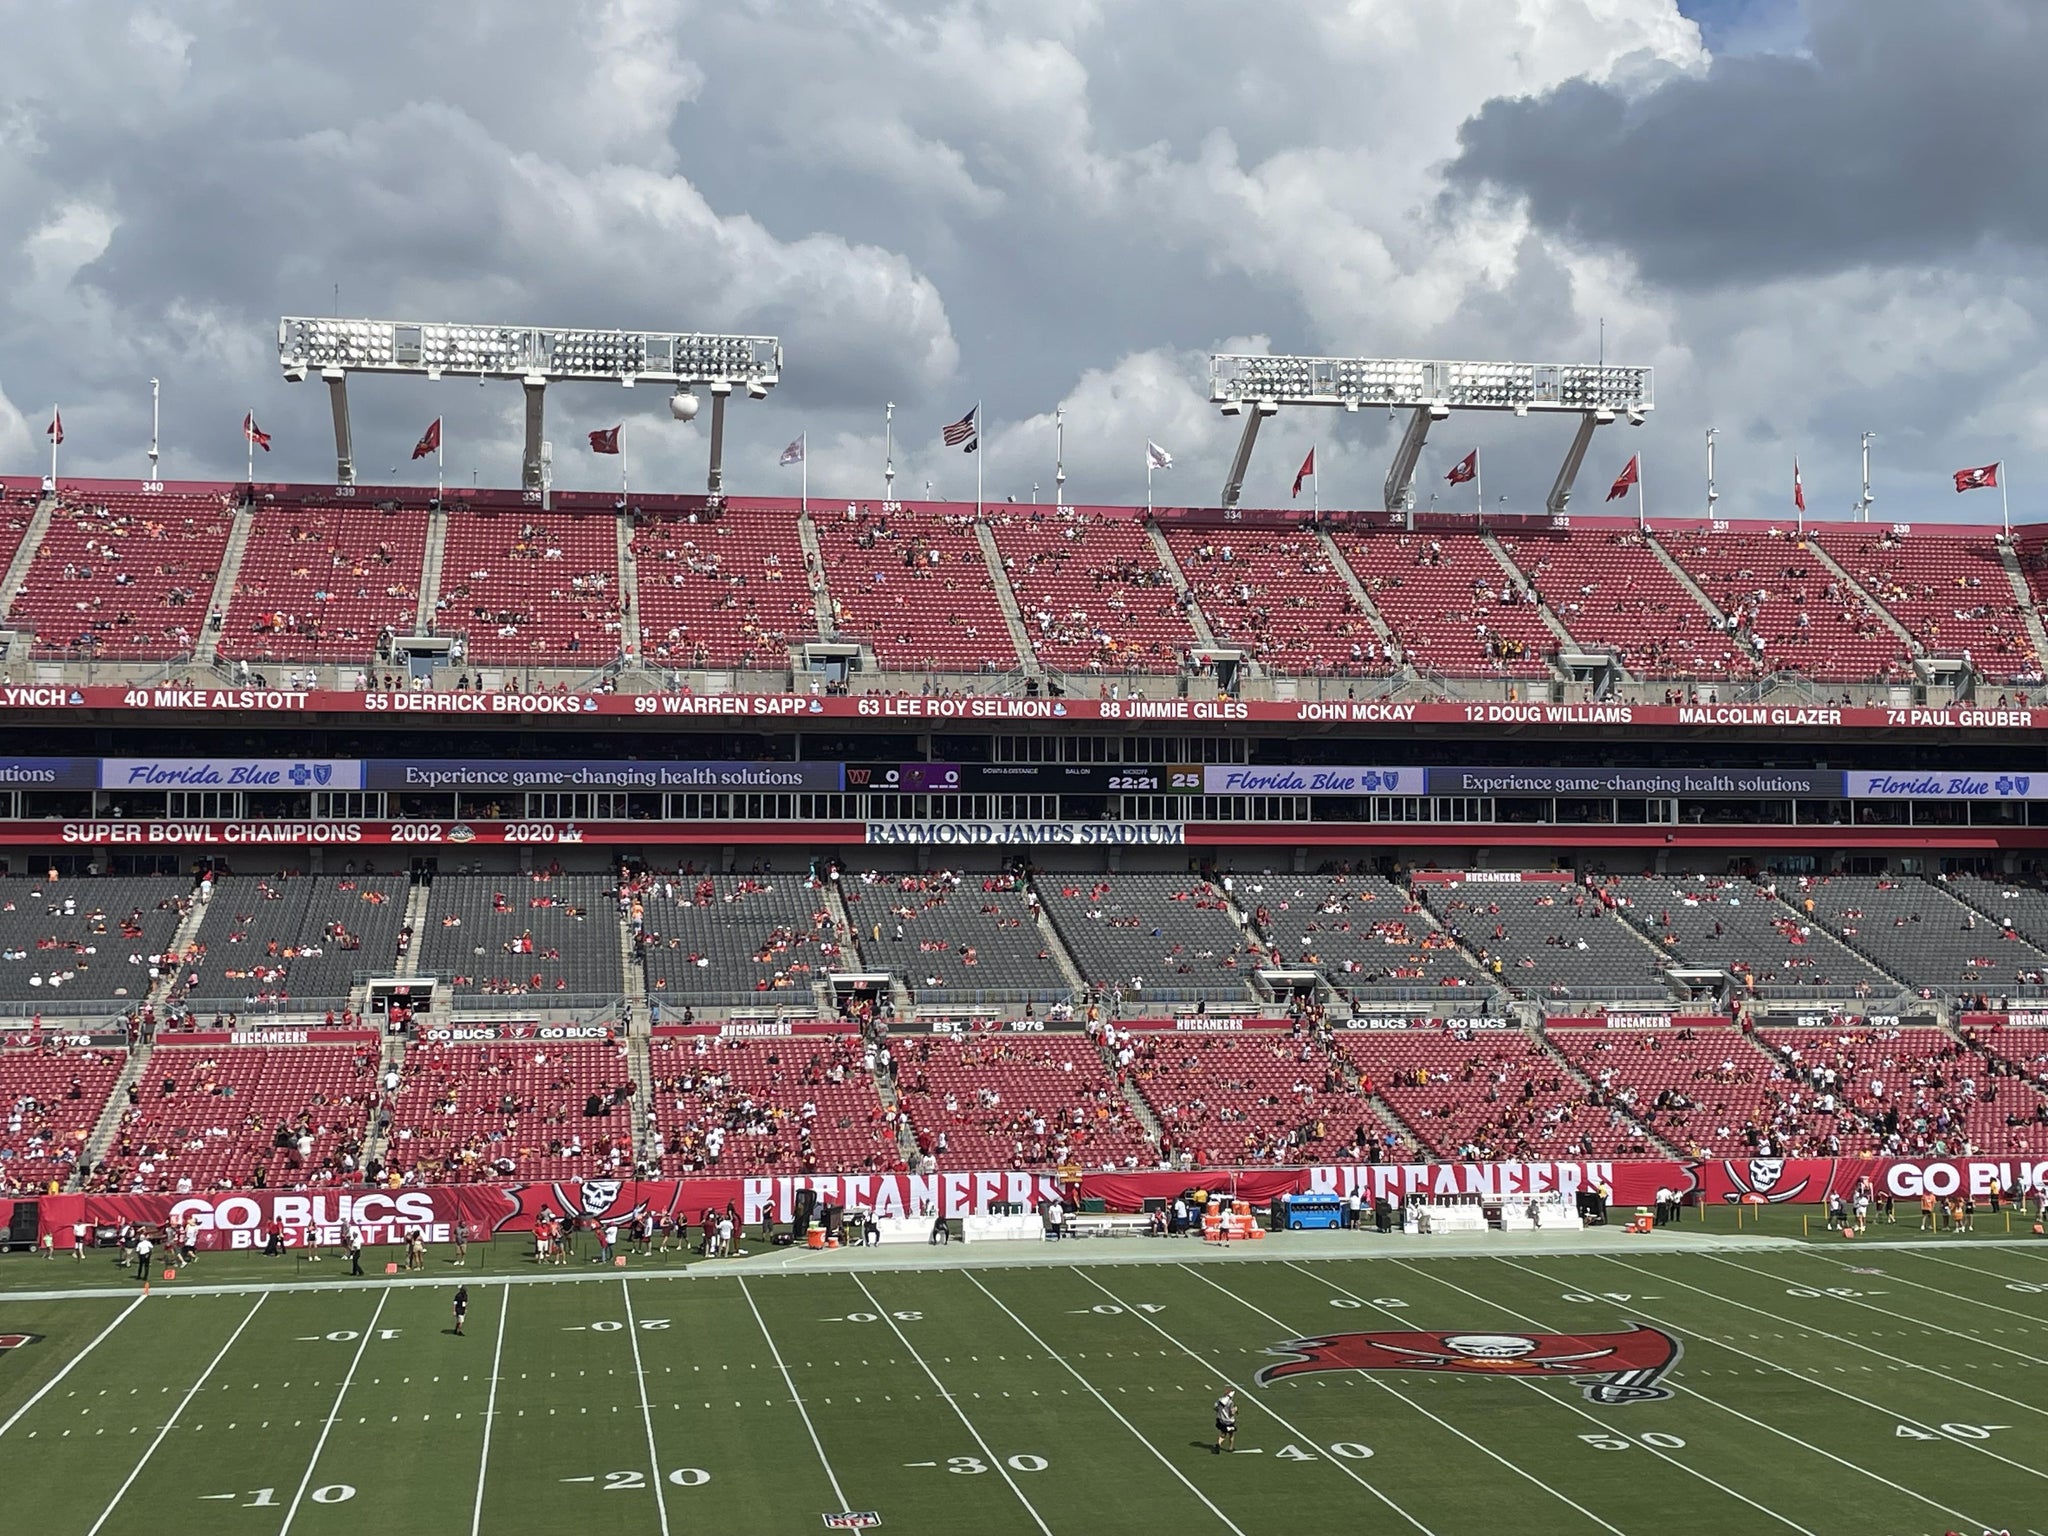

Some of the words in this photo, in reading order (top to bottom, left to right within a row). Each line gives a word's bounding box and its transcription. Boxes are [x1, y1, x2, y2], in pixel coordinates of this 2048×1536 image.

[142, 482, 164, 492] 340
[335, 487, 356, 497] 339
[1223, 510, 1242, 519] 334
[1552, 517, 1570, 526] 332
[1713, 521, 1729, 530] 331
[1893, 525, 1910, 534] 330
[124, 690, 149, 707] 40
[154, 691, 207, 708] MIKE
[212, 691, 309, 709] ALSTOTT
[365, 694, 388, 710] 55
[394, 694, 486, 711] DERRICK
[492, 695, 580, 712] BROOKS
[635, 697, 657, 713] 99
[662, 697, 748, 714] WARREN
[754, 698, 806, 714] SAPP
[858, 699, 879, 715] 63
[885, 700, 921, 716] LEE
[927, 700, 966, 716] ROY
[972, 700, 1050, 717] SELMON
[1100, 702, 1120, 718] 88
[1125, 702, 1188, 718] JIMMIE
[1194, 703, 1248, 719] GILES
[1297, 704, 1347, 720] JOHN
[1352, 705, 1415, 720] MCKAY
[1464, 706, 1484, 721] 12
[1489, 706, 1541, 722] DOUG
[1546, 707, 1632, 723] WILLIAMS
[1679, 708, 1767, 724] MALCOLM
[1771, 709, 1841, 725] GLAZER
[1887, 710, 1906, 725] 74
[1911, 710, 1955, 726] PAUL
[1959, 711, 2032, 727] GRUBER
[128, 764, 222, 785] Florida
[227, 765, 280, 785] Blue
[406, 767, 508, 788] Experience
[513, 767, 659, 788] game-changing
[661, 768, 717, 785] health
[721, 768, 802, 785] solutions
[886, 770, 899, 783] 0
[945, 770, 959, 783] 0
[1172, 773, 1200, 788] 25
[1226, 771, 1306, 790] Florida
[1310, 772, 1355, 790] Blue
[1108, 776, 1158, 790] 22:21
[1463, 774, 1551, 793] Experience
[1556, 774, 1681, 794] game-changing
[1685, 775, 1734, 792] health
[1738, 775, 1810, 792] solutions
[1868, 776, 1944, 795] Florida
[1947, 777, 1989, 795] Blue
[62, 823, 142, 842] SUPER
[149, 823, 218, 842] BOWL
[224, 823, 361, 843] CHAMPIONS
[391, 824, 442, 842] 2002
[504, 824, 555, 842] 2020
[868, 823, 993, 844] RAYMOND
[995, 823, 1074, 844] JAMES
[1081, 824, 1184, 845] STADIUM
[1466, 872, 1522, 883] BUCCANEERS
[932, 1022, 963, 1032] EST.
[1010, 1021, 1044, 1031] 1976
[1176, 1019, 1243, 1031] BUCCANEERS
[1346, 1019, 1367, 1030] GO
[1370, 1019, 1407, 1030] BUCS
[1446, 1018, 1466, 1029] GO
[1469, 1018, 1506, 1029] BUCS
[1607, 1016, 1671, 1028] BUCCANEERS
[1797, 1016, 1826, 1027] EST.
[1869, 1015, 1900, 1026] 1976
[2009, 1014, 2048, 1025] BUCCAN
[427, 1029, 450, 1040] GO
[453, 1028, 495, 1040] BUCS
[540, 1028, 567, 1038] GO
[569, 1027, 607, 1038] BUCS
[721, 1024, 792, 1036] BUCCANEERS
[231, 1031, 308, 1044] BUCCANEERS
[1887, 1162, 1961, 1197] GO
[169, 1197, 262, 1230] GO
[273, 1192, 435, 1228] BUCS
[1637, 1218, 1647, 1228] G
[1329, 1297, 1410, 1310] 50
[1562, 1292, 1633, 1304] 40
[1092, 1303, 1167, 1315] 40
[847, 1310, 924, 1323] 30
[592, 1319, 671, 1332] 20
[326, 1328, 403, 1342] 10
[1896, 1423, 1991, 1441] 40
[1577, 1432, 1687, 1452] 50
[1275, 1441, 1375, 1461] 40
[947, 1454, 1049, 1475] 30
[603, 1468, 711, 1490] 20
[242, 1484, 357, 1508] 10
